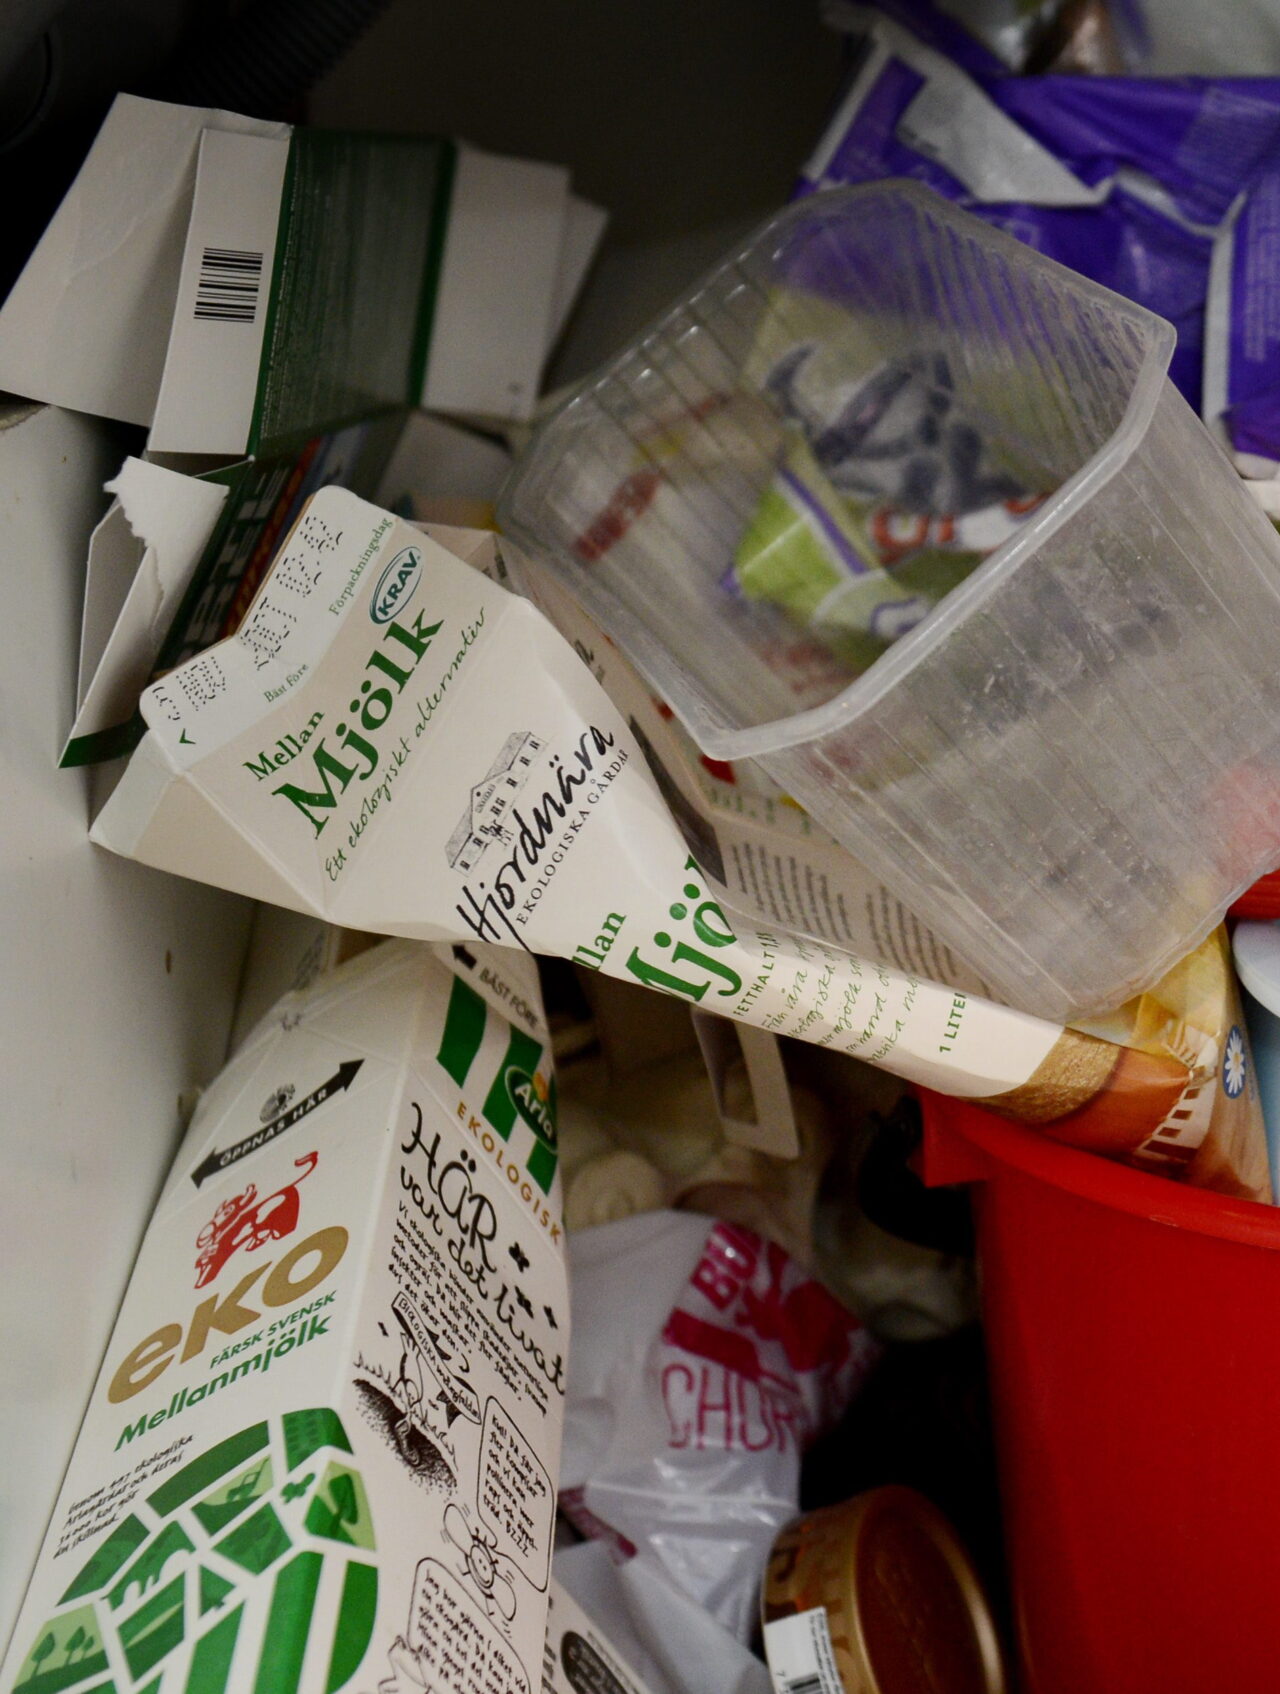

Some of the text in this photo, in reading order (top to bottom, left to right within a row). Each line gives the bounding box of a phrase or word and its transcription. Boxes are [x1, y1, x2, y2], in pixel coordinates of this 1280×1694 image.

[328, 517, 394, 616] Förpackningsdag
[378, 551, 419, 616] KRAV
[263, 663, 309, 703] Bäst Före
[242, 711, 325, 782] Mellan
[271, 607, 444, 840] Mjölk
[325, 607, 486, 882] Ett ekologiskt alternativ
[516, 808, 590, 925] EKOLOGISKA
[587, 749, 629, 804] GÅRDAR
[480, 967, 539, 1029] BÄST FÖRE
[733, 950, 775, 1017] FETTHALT
[939, 1045, 952, 1054] 1
[219, 1089, 327, 1167] ÖPPNAS HÄR
[515, 1082, 554, 1136] Arla
[457, 1101, 561, 1247] EKOLOGISK
[400, 1165, 566, 1396] var det livat
[210, 1290, 337, 1370] FÄRSK SVENSK
[399, 1298, 436, 1365] BIOLOGISKA
[114, 1314, 332, 1453] Mellanmjölk
